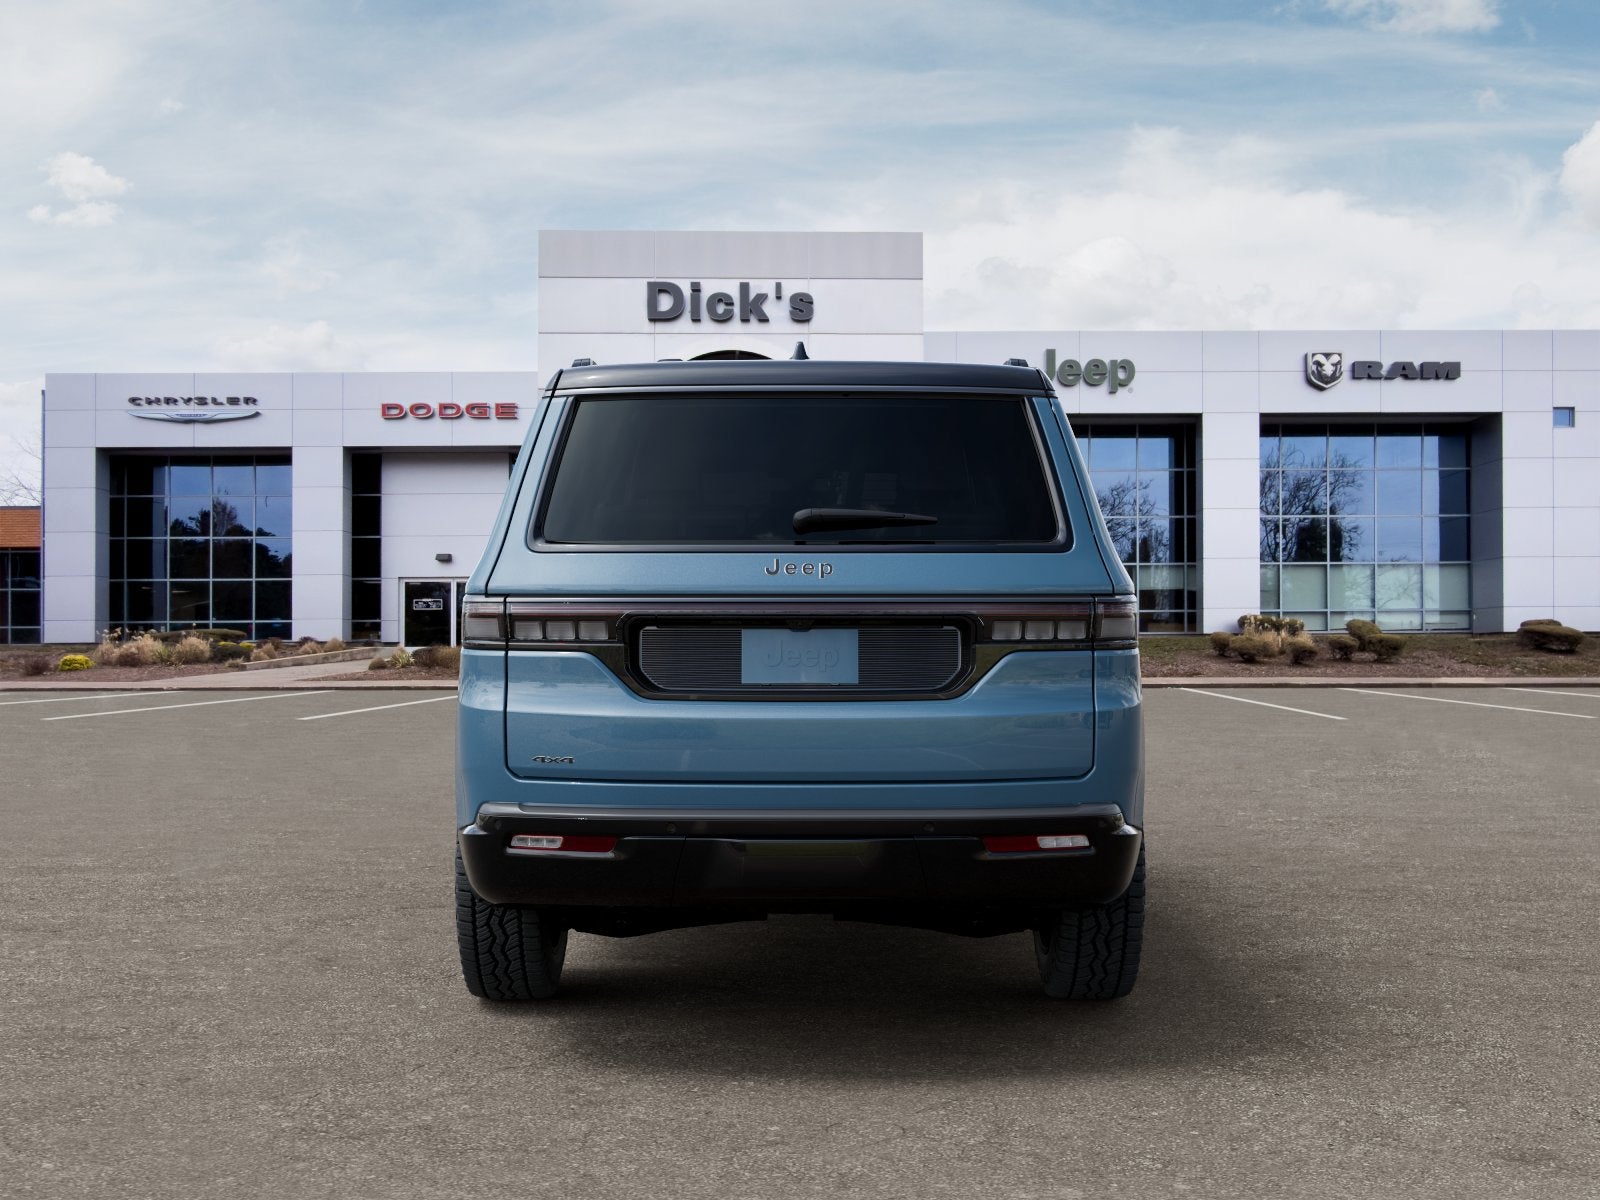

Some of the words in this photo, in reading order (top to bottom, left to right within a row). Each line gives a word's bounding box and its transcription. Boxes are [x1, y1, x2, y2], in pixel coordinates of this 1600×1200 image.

[646, 281, 814, 322] Dick's
[1351, 360, 1462, 380] RAM
[127, 396, 259, 406] CHRYSLER
[381, 402, 519, 420] DODGE
[764, 558, 834, 580] Jeep
[762, 640, 840, 673] Jeep
[531, 755, 576, 764] 4x4
